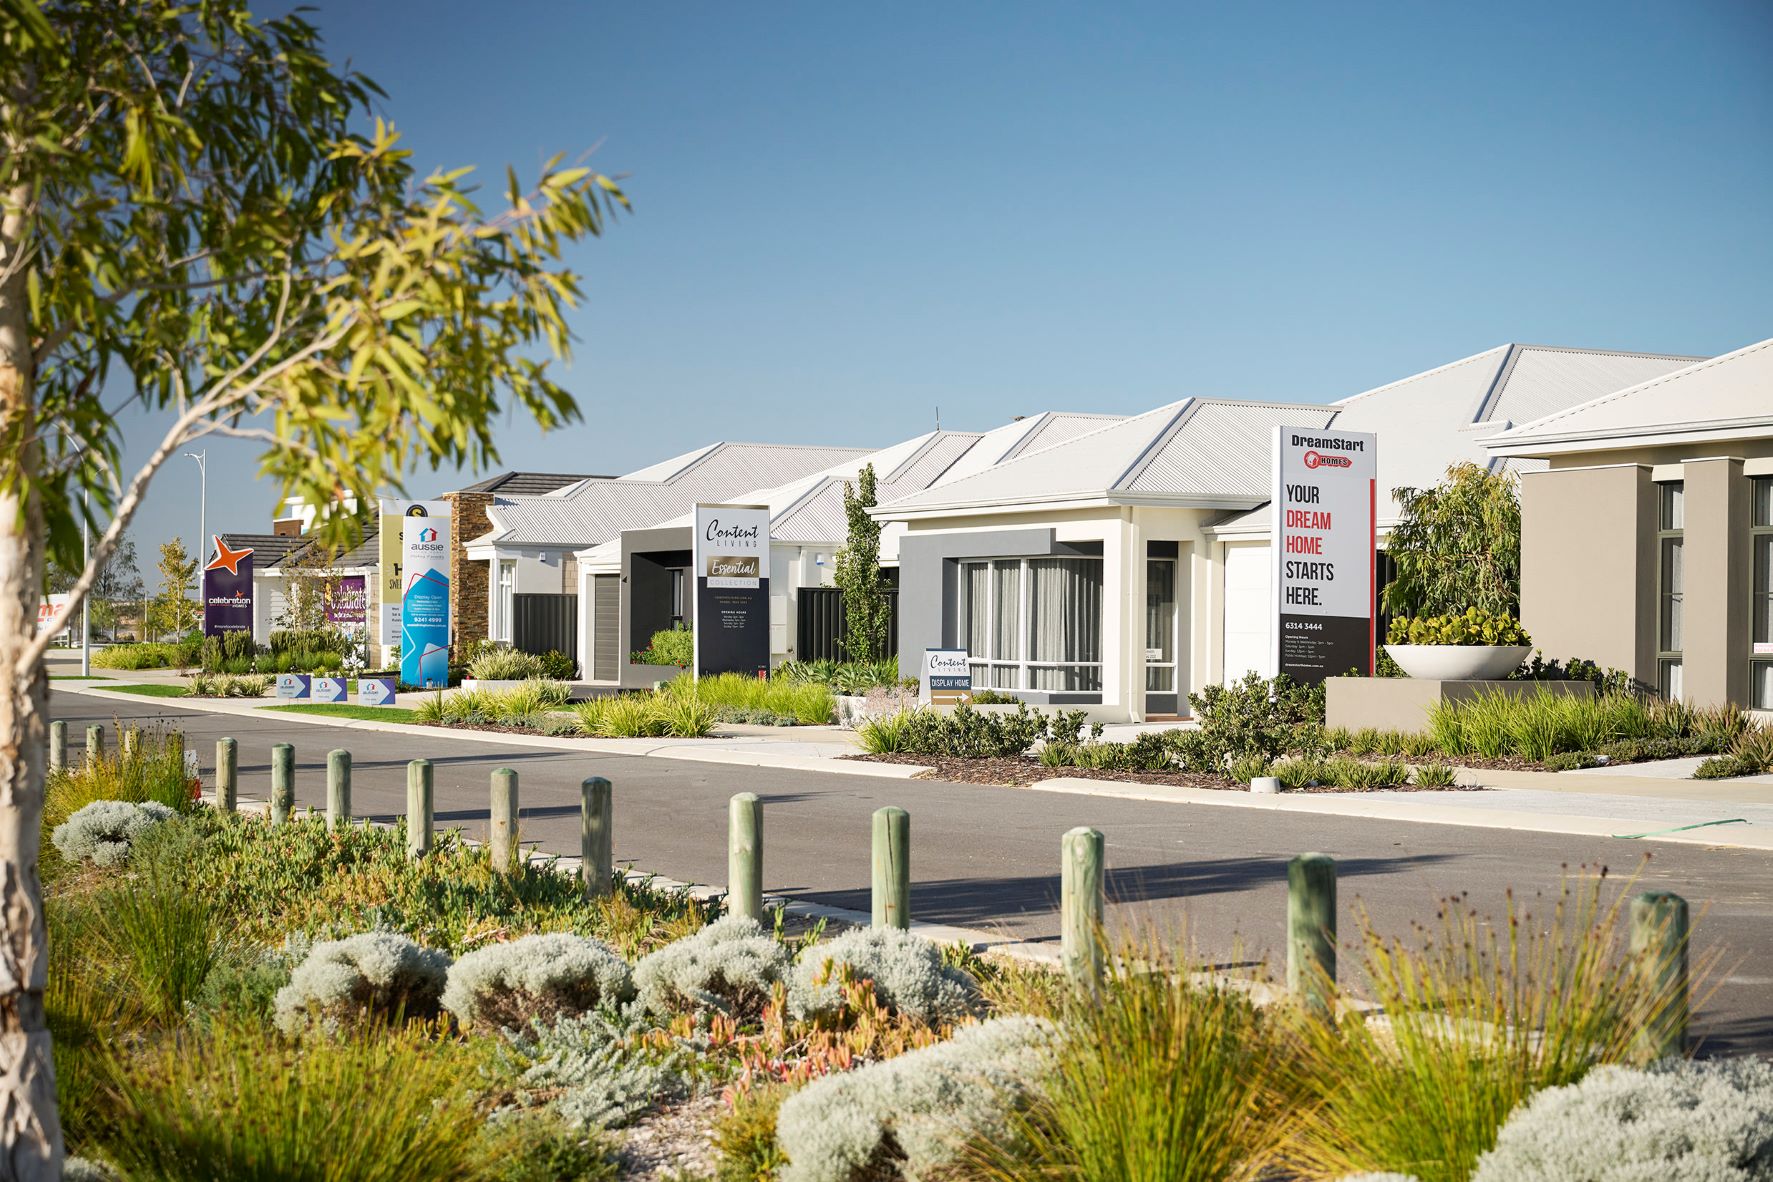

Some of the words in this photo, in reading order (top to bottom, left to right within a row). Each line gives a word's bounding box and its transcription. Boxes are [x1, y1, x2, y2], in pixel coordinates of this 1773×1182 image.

[1291, 435, 1364, 451] DreamStart
[1321, 457, 1348, 465] HOMES
[1286, 484, 1320, 504] YOUR
[1286, 510, 1332, 530] DREAM
[706, 519, 759, 541] Content
[1286, 535, 1323, 555] HOME
[711, 560, 756, 575] Essential
[1285, 560, 1334, 581] STARTS
[1286, 586, 1323, 606] HERE.
[1285, 622, 1303, 630] 6314
[1304, 622, 1323, 631] 3444
[930, 655, 967, 668] Content
[931, 679, 953, 687] DISPLAY
[954, 679, 970, 687] HOME
